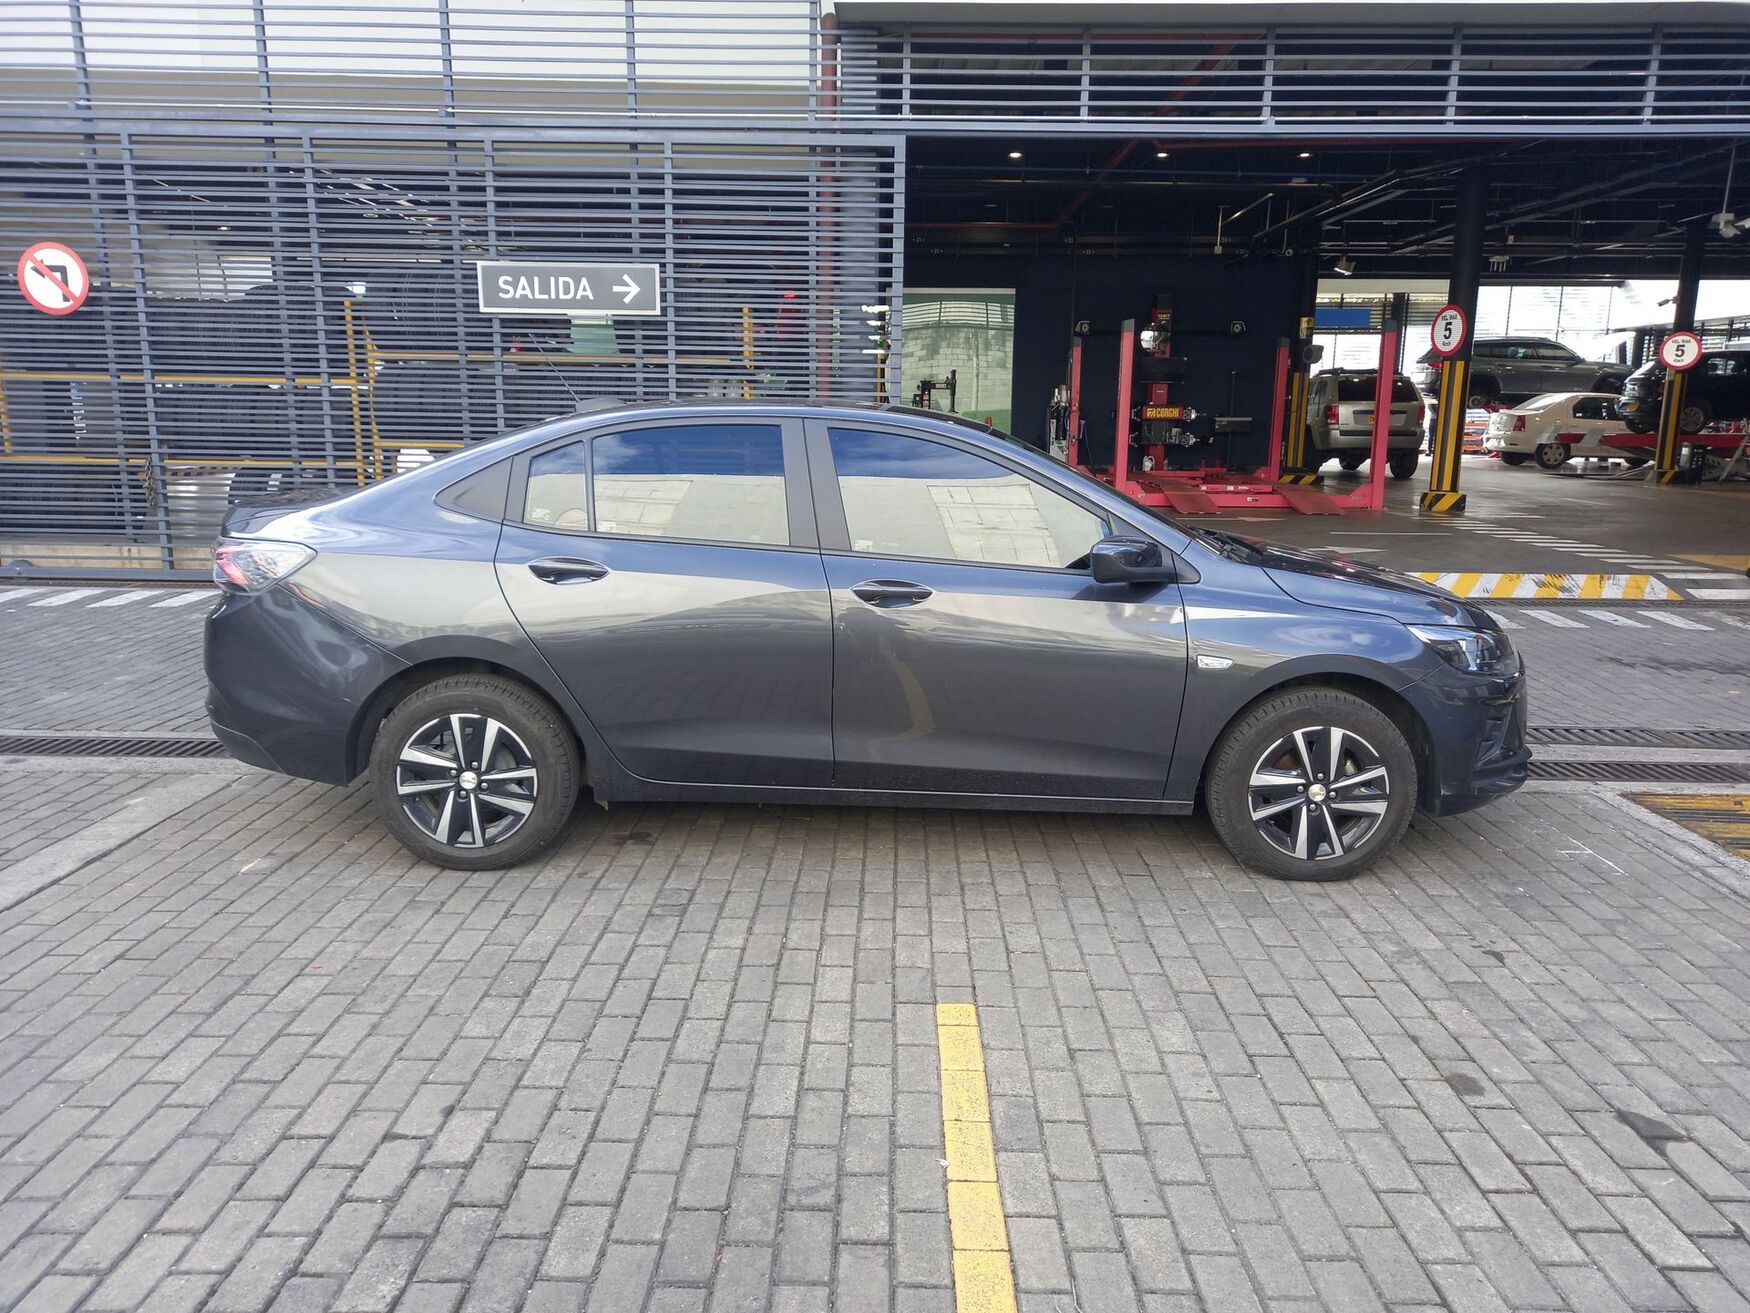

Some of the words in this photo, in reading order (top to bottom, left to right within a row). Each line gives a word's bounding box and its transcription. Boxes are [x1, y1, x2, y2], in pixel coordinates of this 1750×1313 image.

[498, 275, 594, 300] SALIDA
[1444, 322, 1452, 340] 5
[1674, 344, 1686, 358] 5
[1156, 407, 1180, 418] CORGHI
